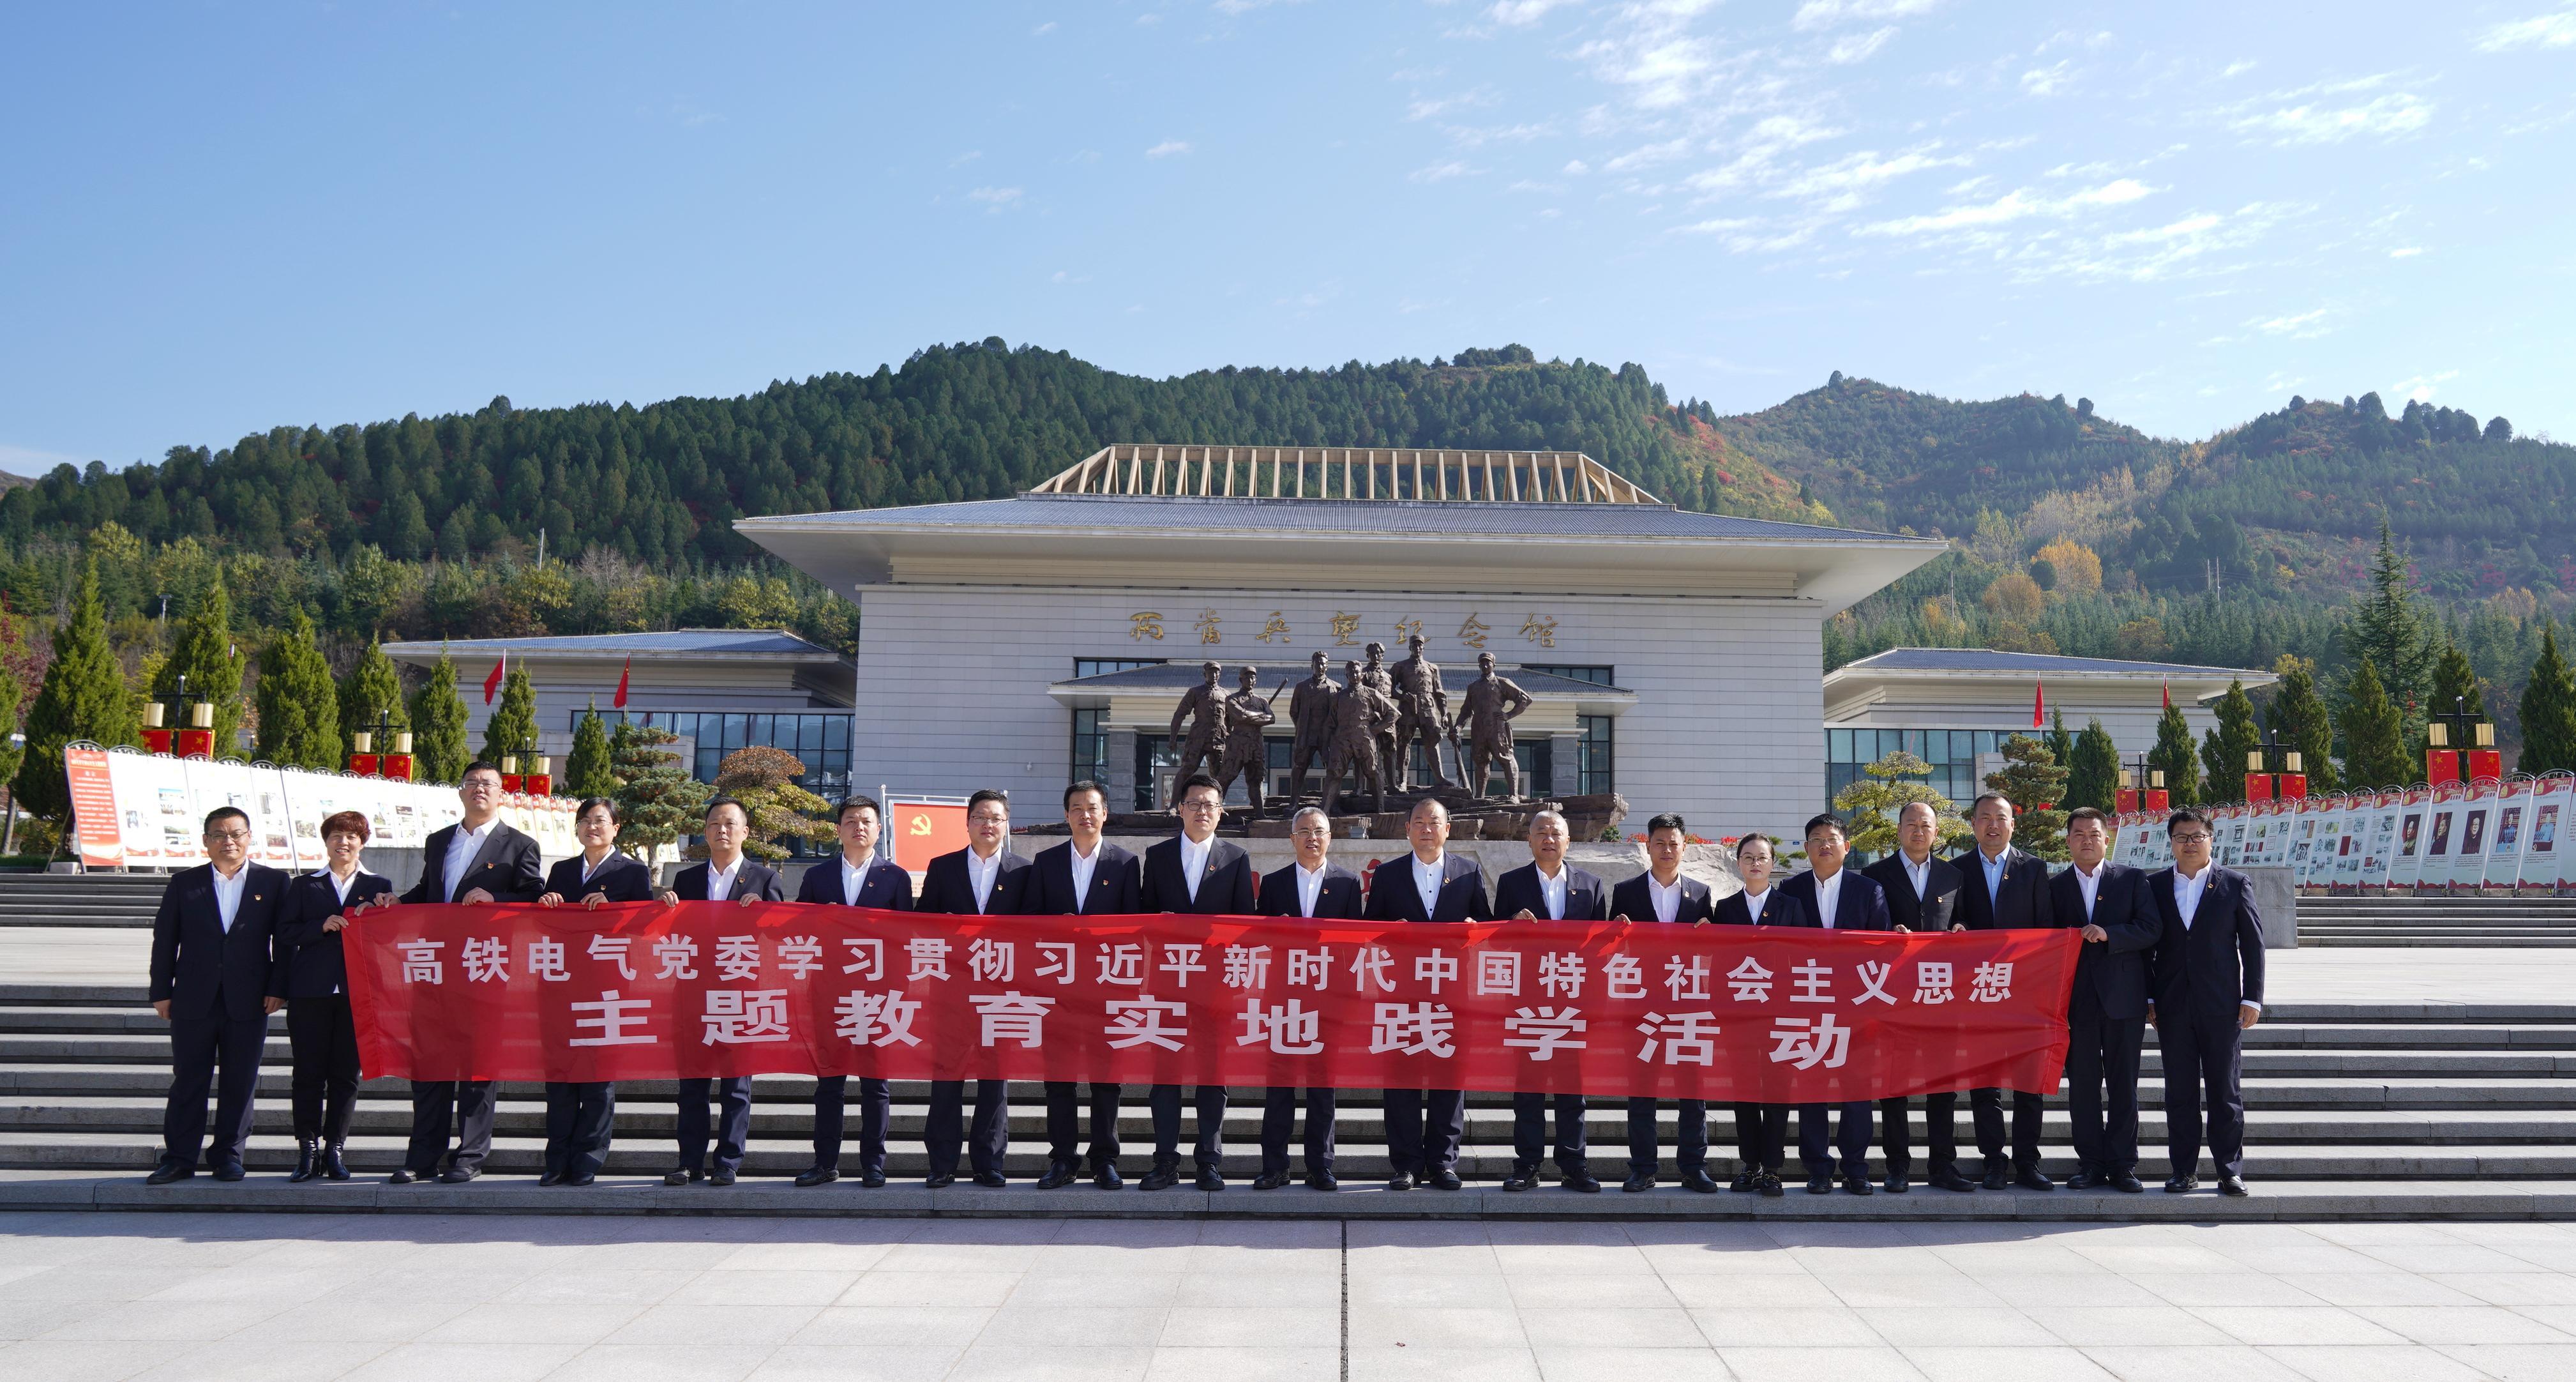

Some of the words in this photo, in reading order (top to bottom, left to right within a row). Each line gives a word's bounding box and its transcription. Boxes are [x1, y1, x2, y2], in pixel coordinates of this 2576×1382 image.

[397, 934, 2014, 1006] 高铁电气党委学习贯彻习近平新时代中国特色社会主义思想
[569, 989, 1851, 1071] 主题教育实地践学活动
